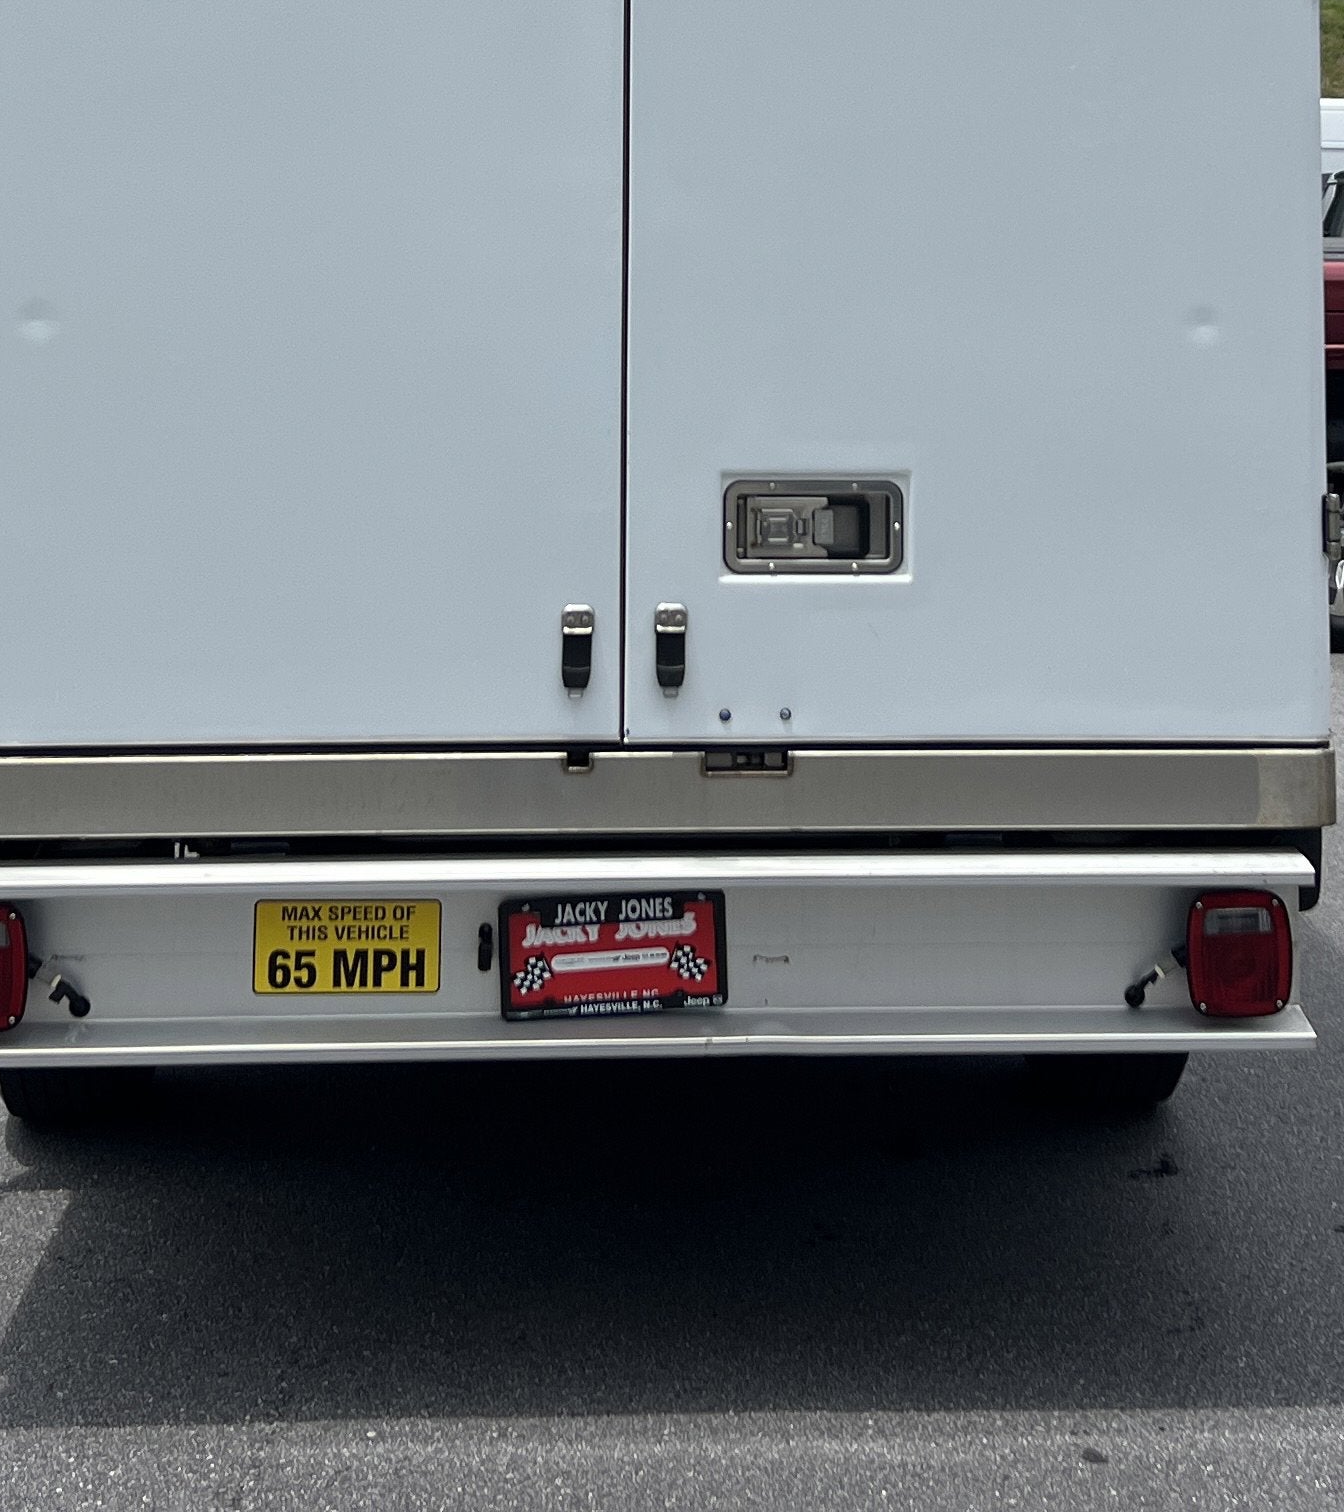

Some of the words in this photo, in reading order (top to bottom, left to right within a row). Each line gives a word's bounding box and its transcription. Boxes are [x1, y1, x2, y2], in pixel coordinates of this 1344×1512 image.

[281, 905, 322, 921] MAX
[328, 905, 387, 921] SPEED
[392, 904, 417, 920] OF
[554, 900, 608, 924] JACKY
[618, 897, 674, 921] JONES
[286, 925, 329, 941] THIS
[334, 925, 410, 941] VEHICLE
[521, 923, 601, 949] JACKY
[615, 911, 698, 940] JONES
[266, 948, 317, 989] 65
[331, 947, 426, 989] MPH
[683, 995, 710, 1007] Jeep
